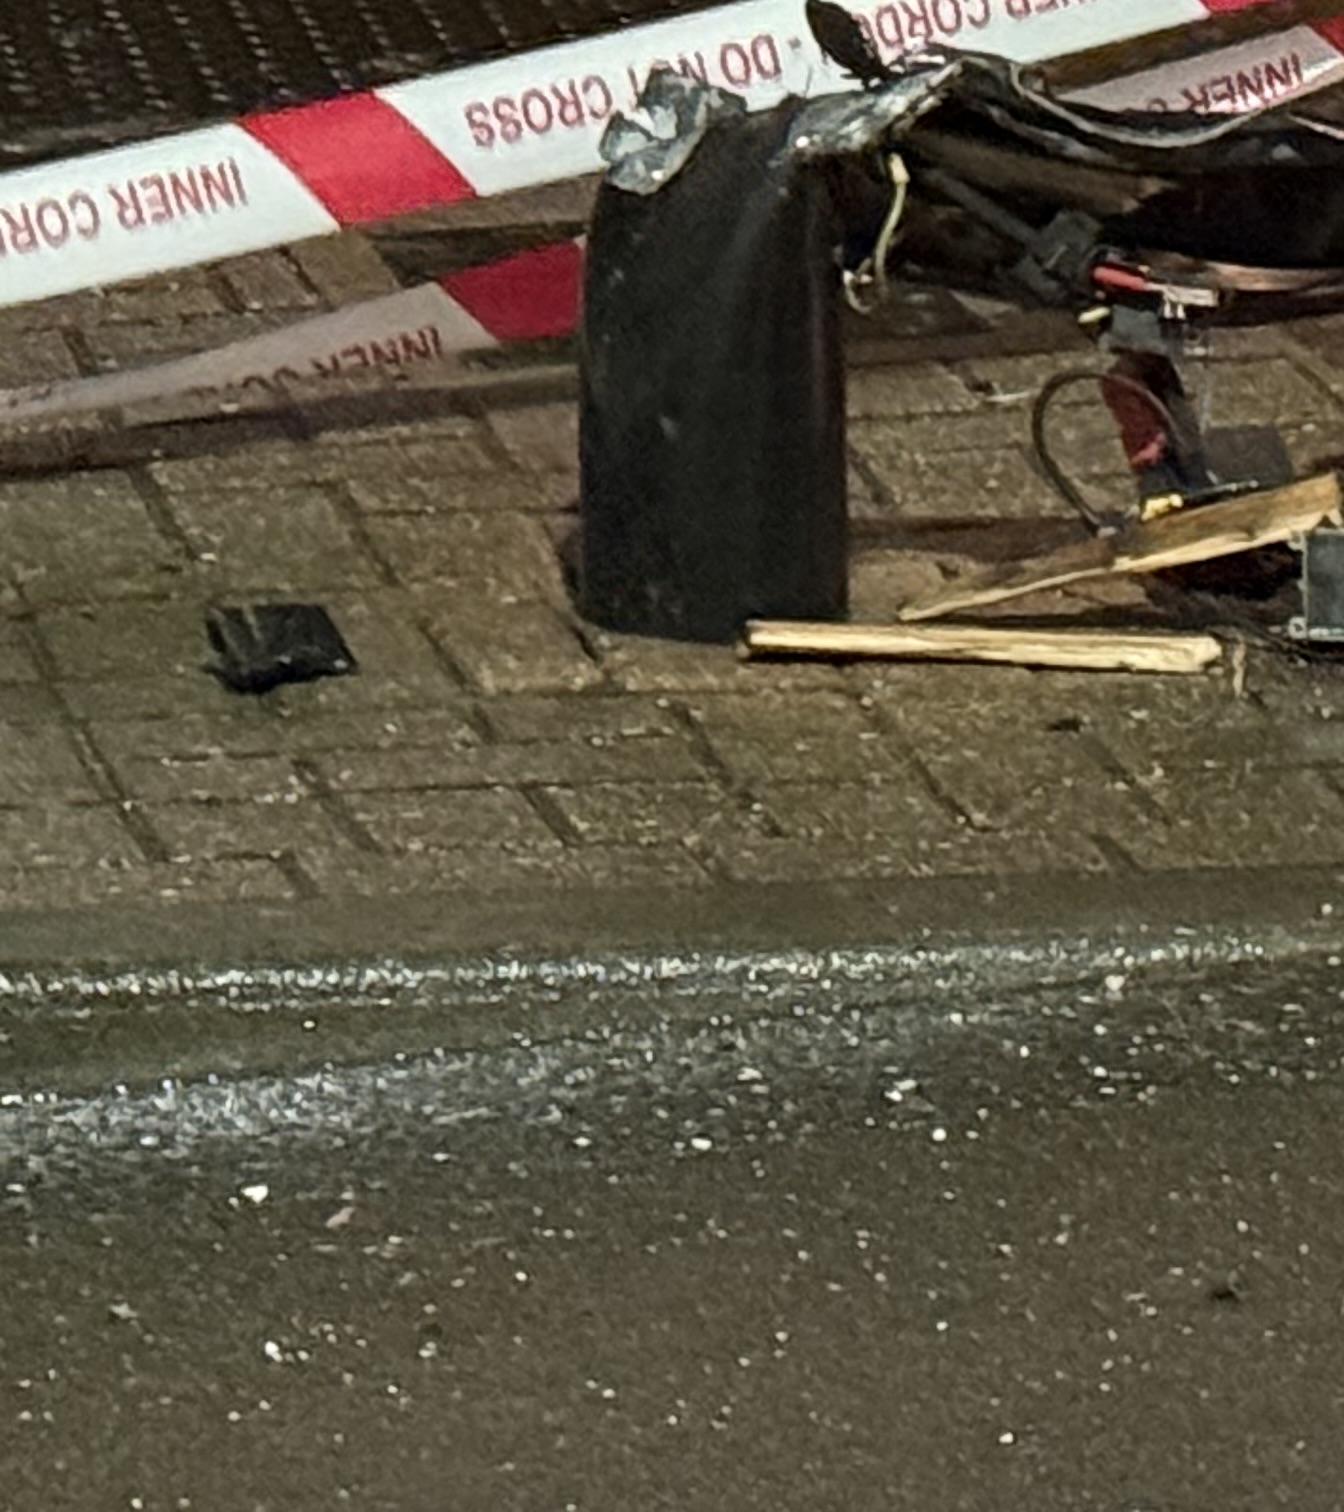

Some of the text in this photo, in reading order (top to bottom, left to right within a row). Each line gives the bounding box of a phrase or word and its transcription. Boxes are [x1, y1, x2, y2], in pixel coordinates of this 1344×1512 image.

[718, 33, 781, 88] DO
[463, 74, 614, 148] CROSS
[0, 155, 248, 256] INNER COR
